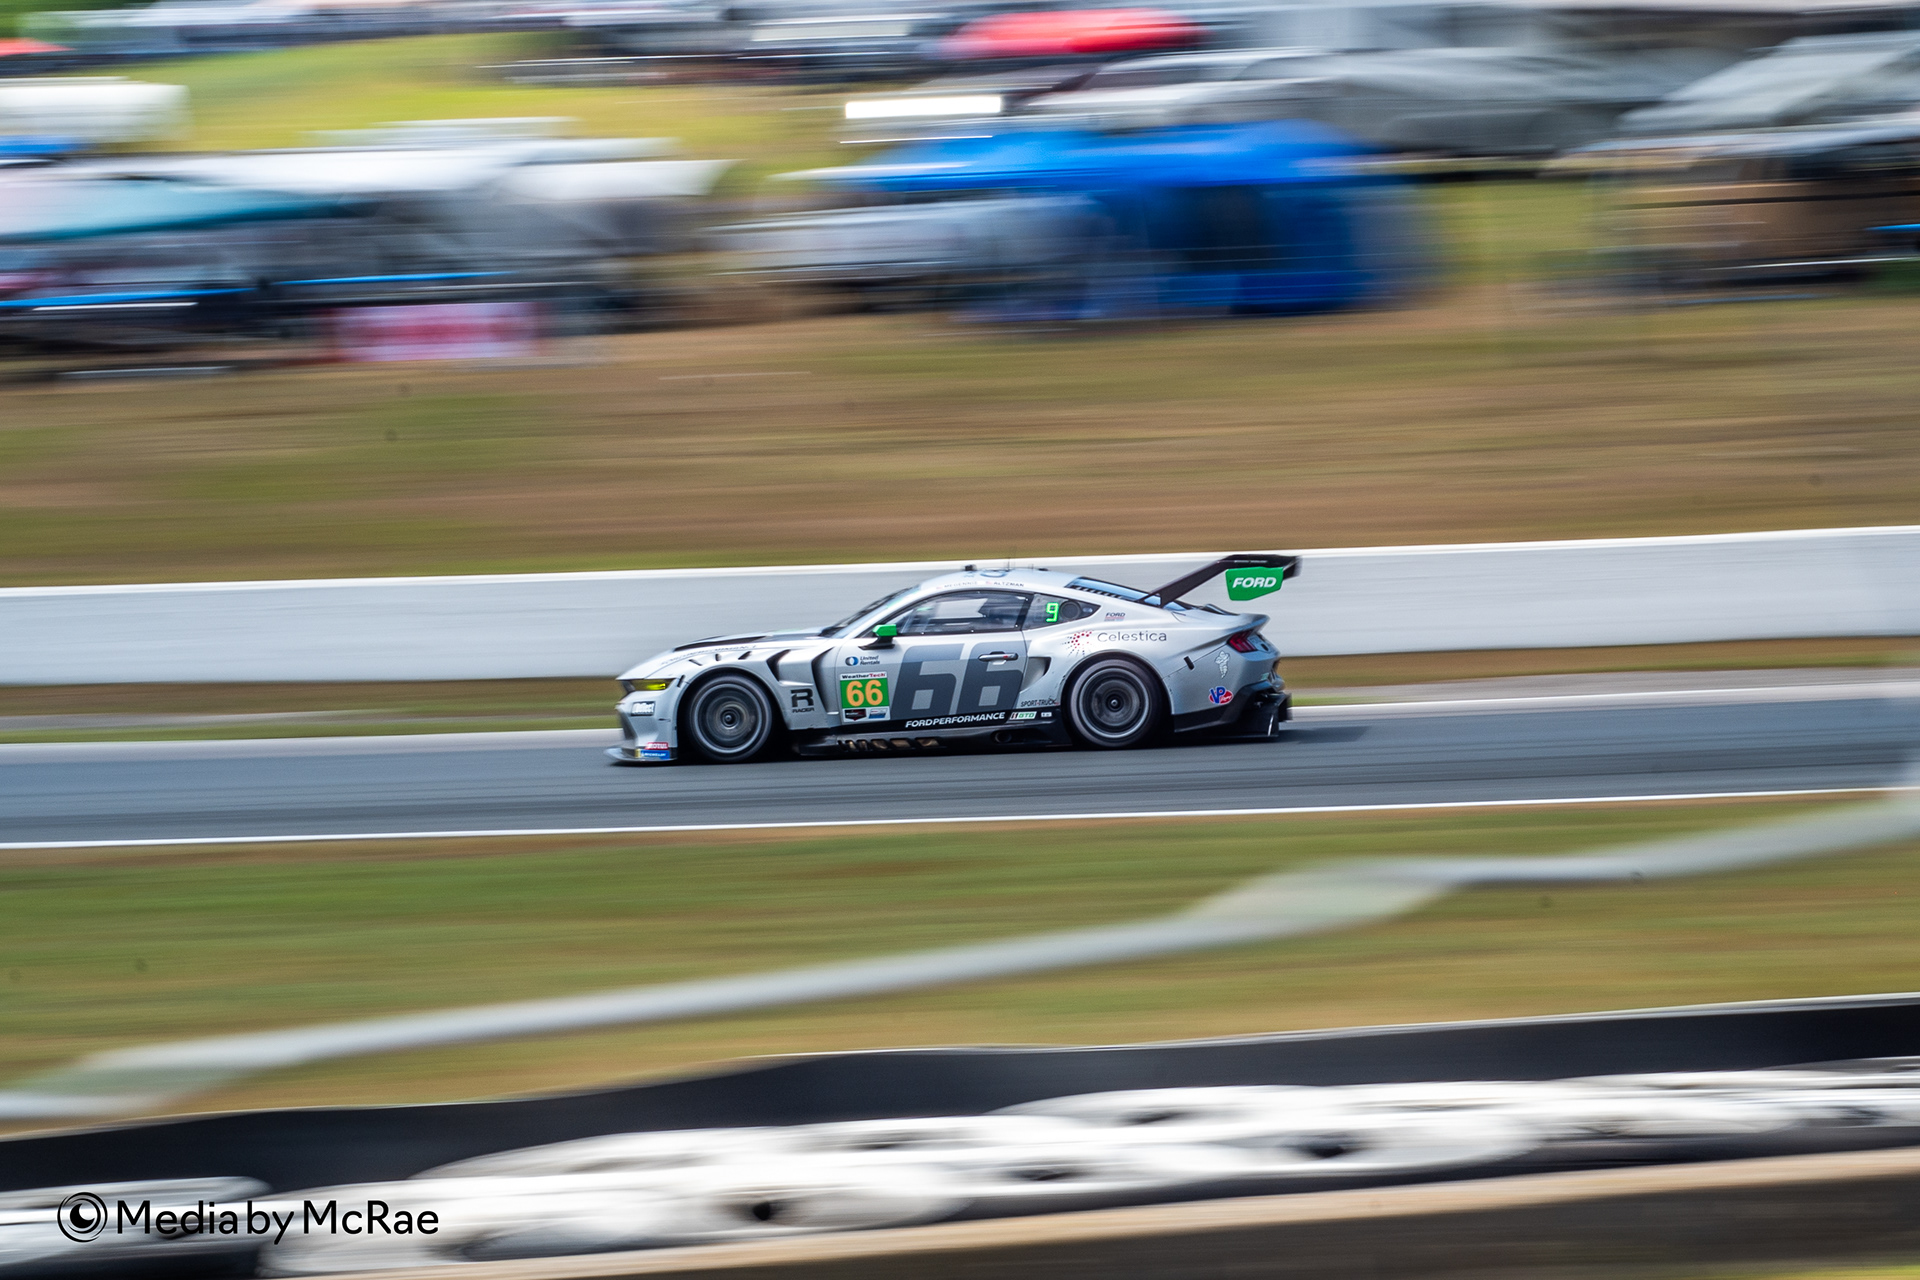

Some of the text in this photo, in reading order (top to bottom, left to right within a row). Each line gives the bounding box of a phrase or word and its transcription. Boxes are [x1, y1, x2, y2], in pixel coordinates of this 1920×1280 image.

[1232, 577, 1277, 588] FORD
[1046, 602, 1059, 622] 9
[1097, 631, 1167, 642] Celestica
[890, 640, 1032, 720] 66
[846, 679, 883, 707] 66
[1210, 687, 1225, 704] VP
